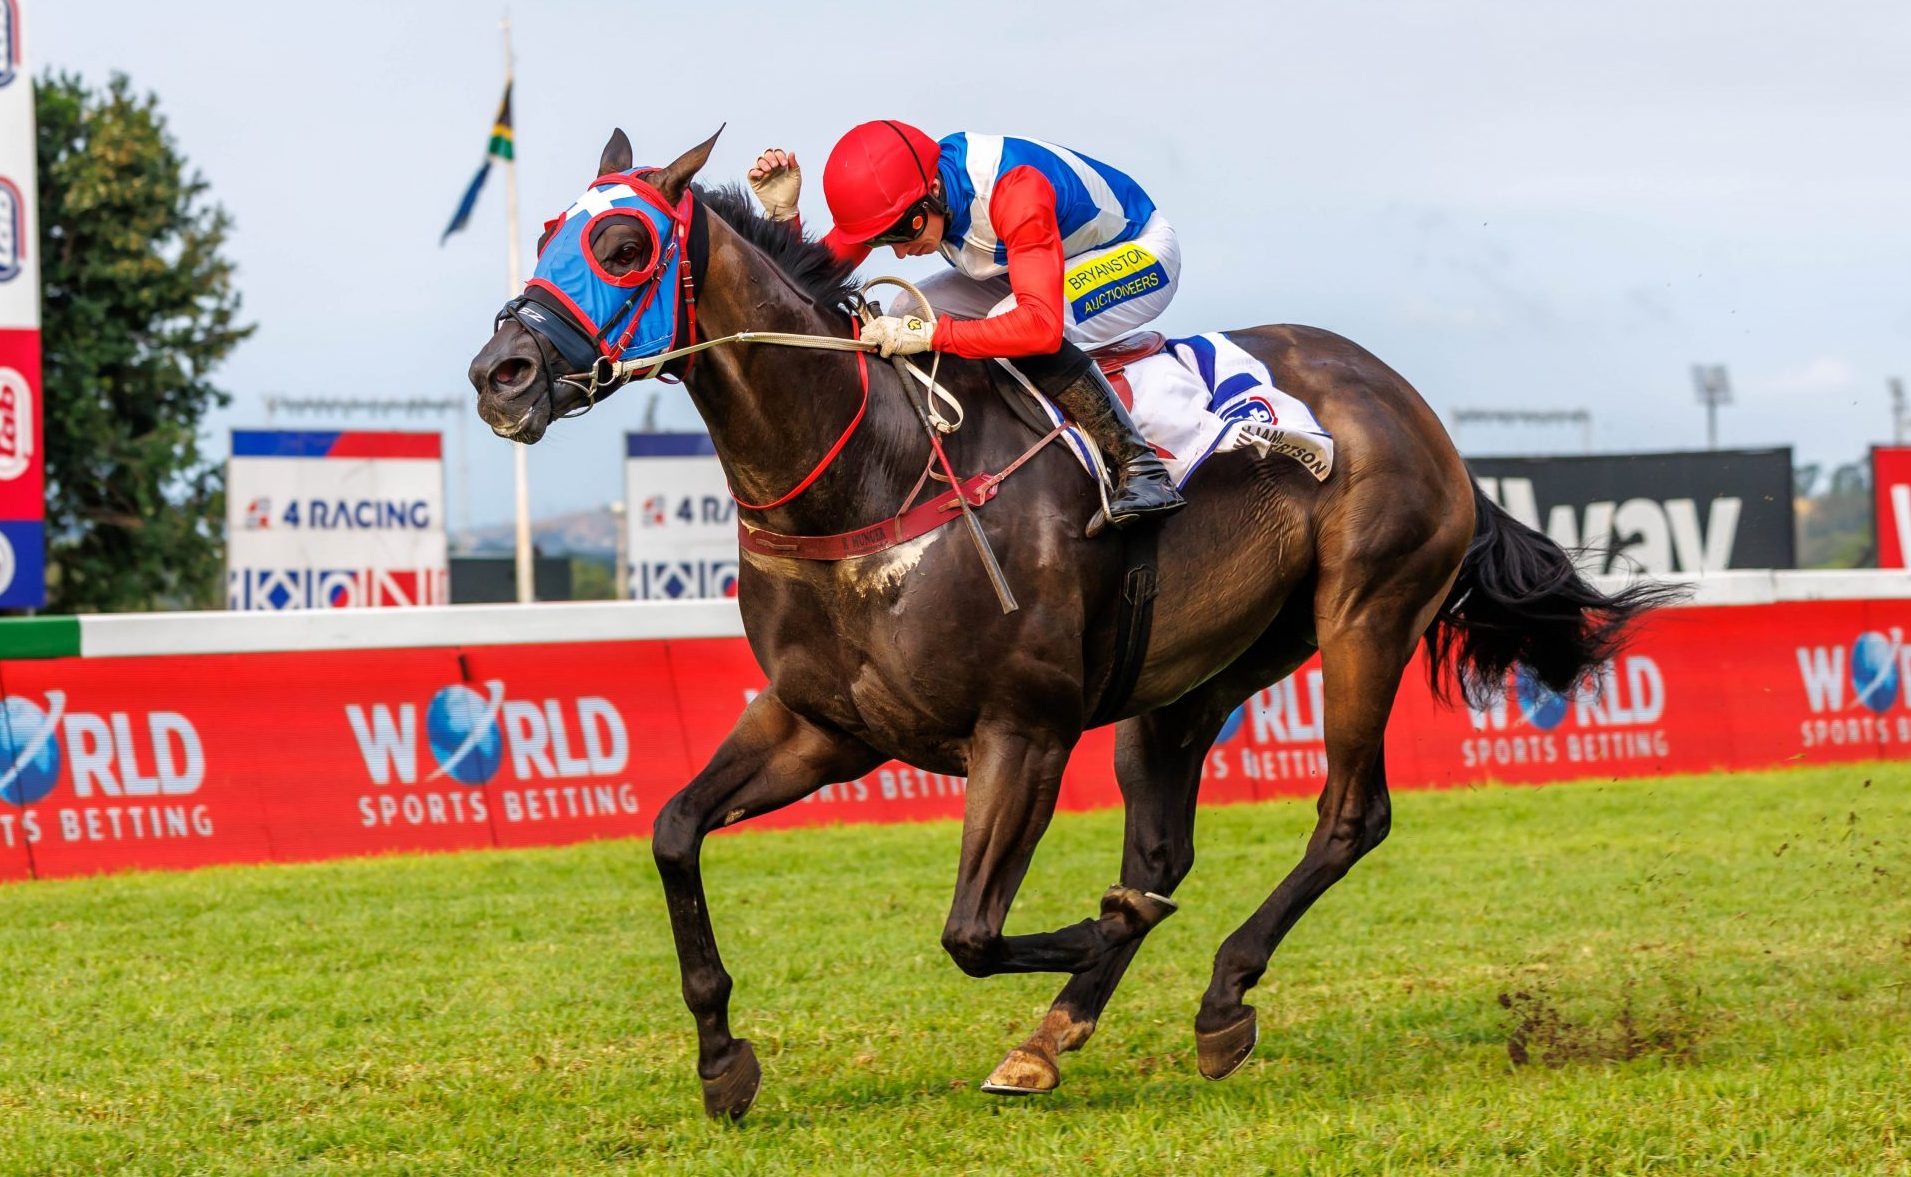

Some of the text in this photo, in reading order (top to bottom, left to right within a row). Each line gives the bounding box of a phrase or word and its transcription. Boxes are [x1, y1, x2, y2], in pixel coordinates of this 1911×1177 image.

[1068, 249, 1148, 290] BRYANSTON
[1085, 272, 1159, 314] AUCTIONEERS
[283, 500, 430, 529] 4 RACING
[1462, 729, 1670, 767] SPORTS BETTING
[1801, 716, 1891, 748] SPORTS
[59, 804, 214, 843] BETTING
[358, 784, 639, 827] SPORTS BETTING
